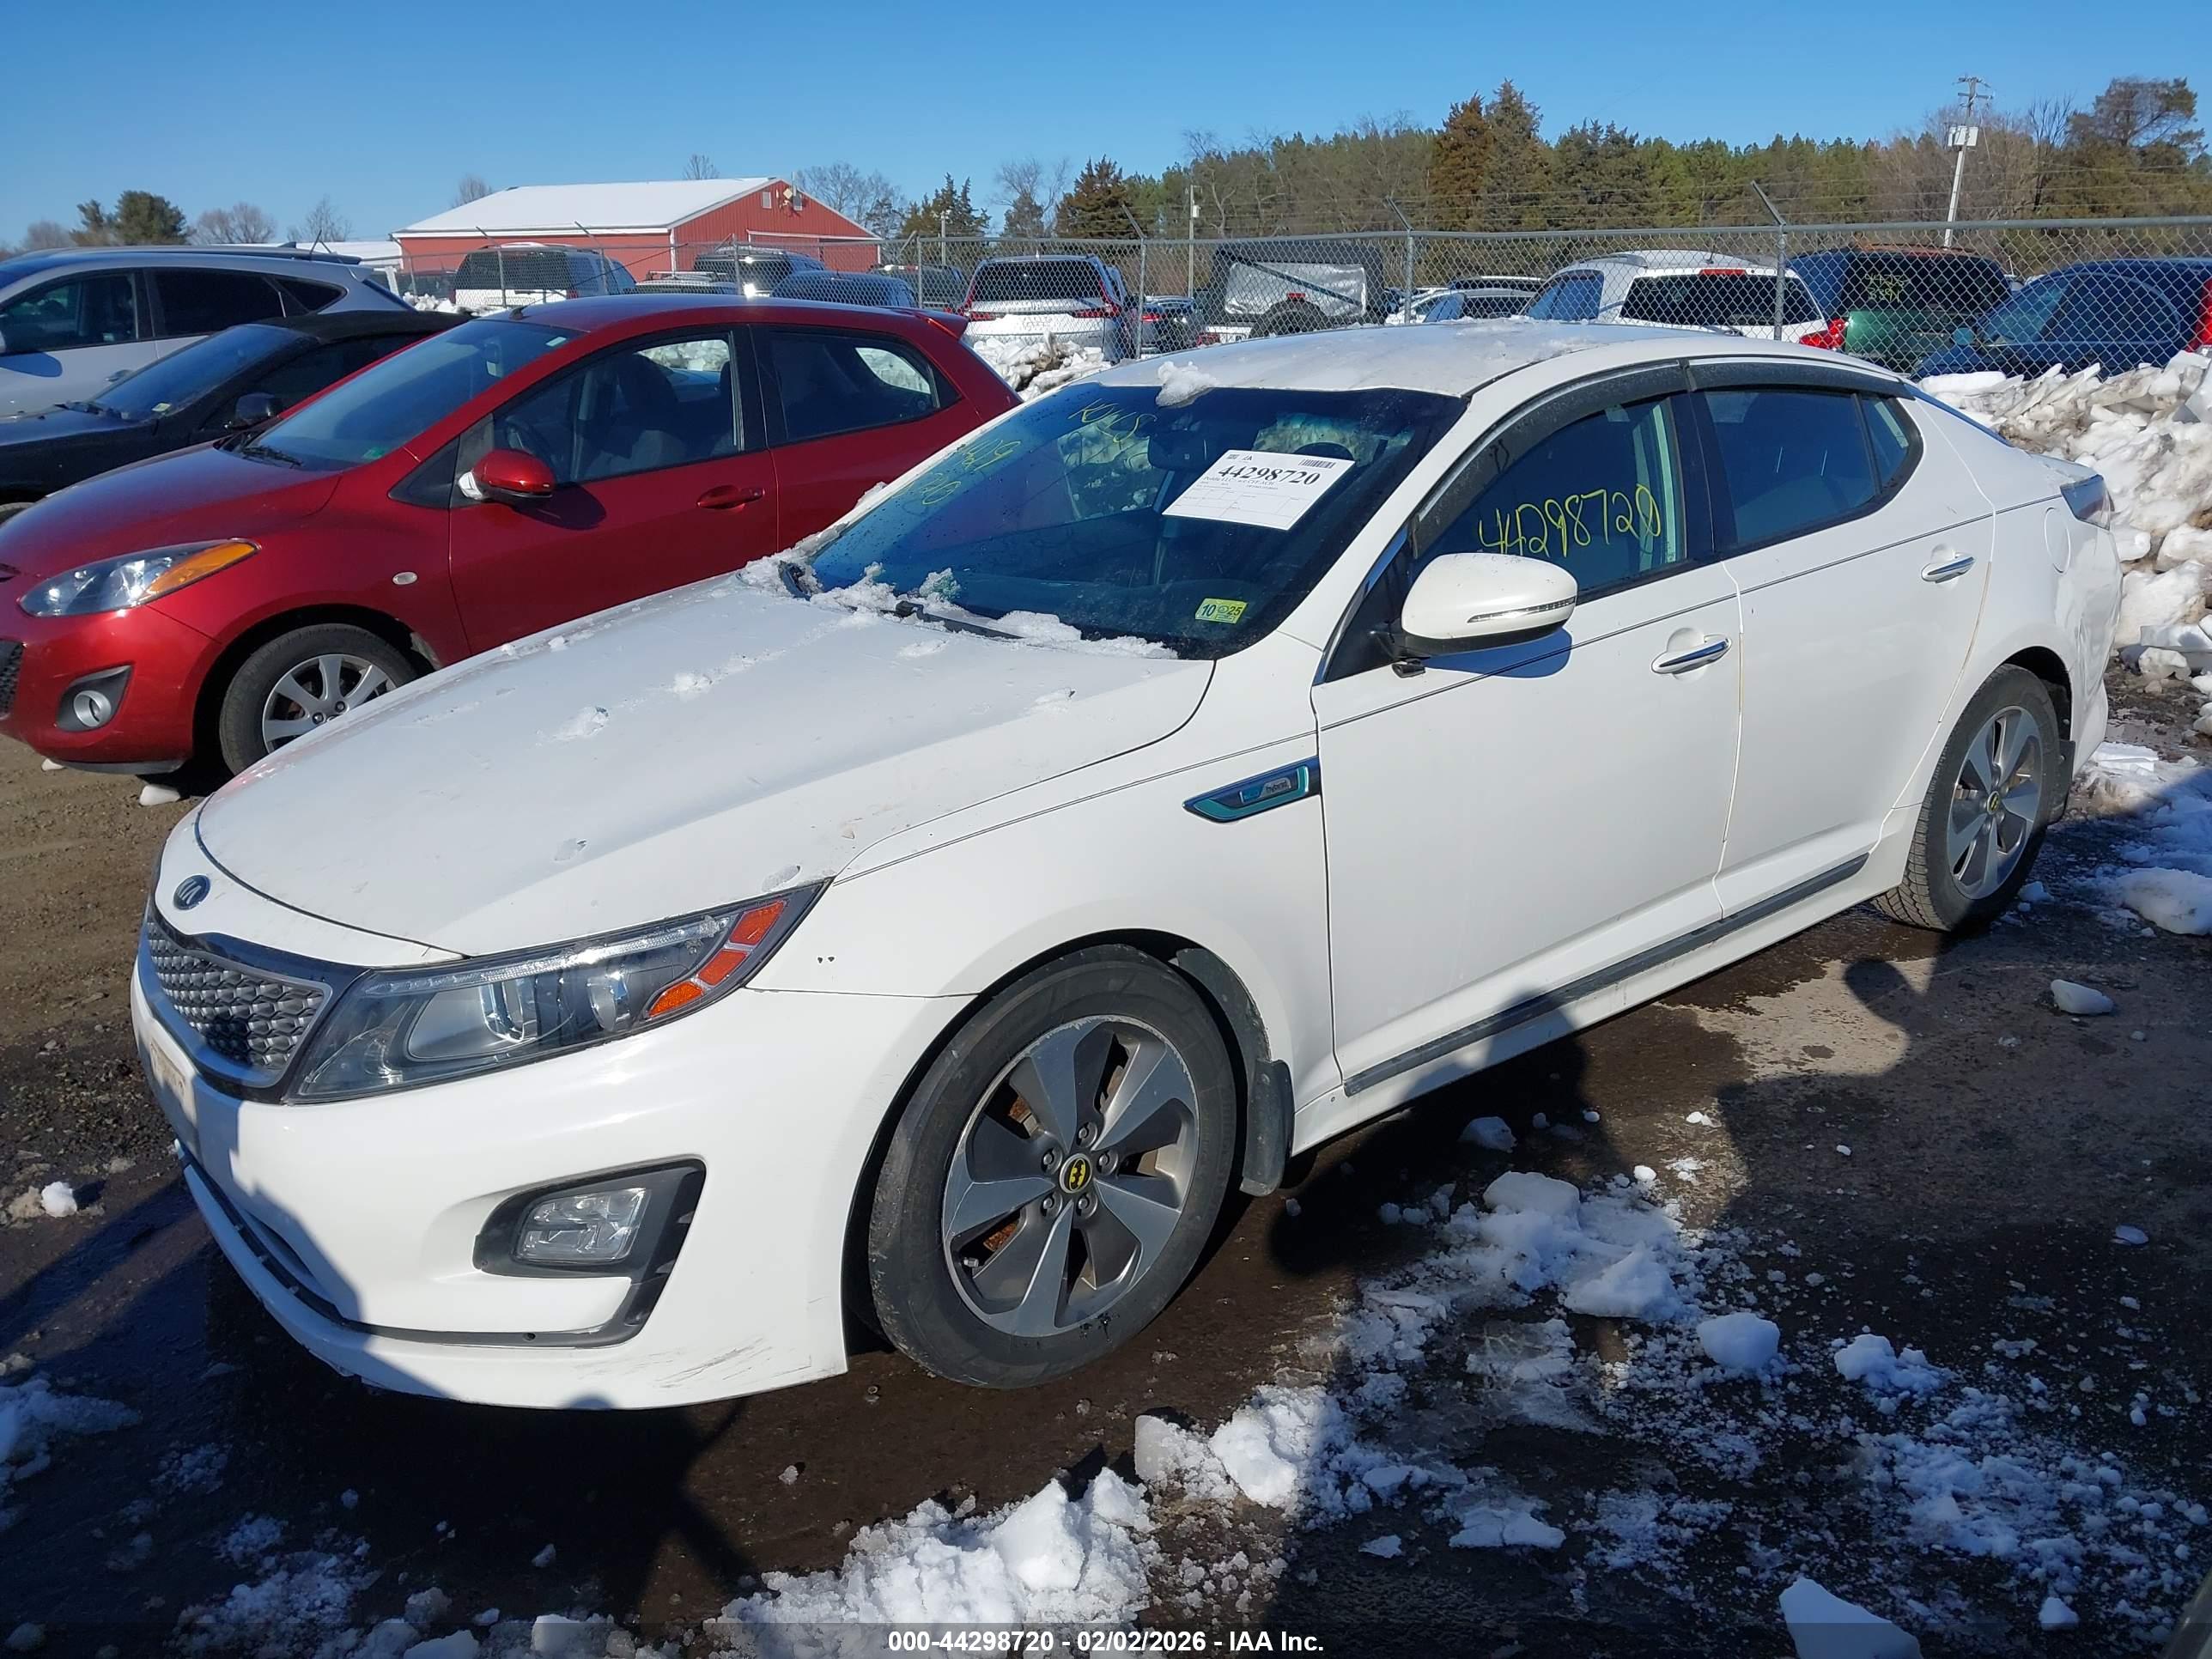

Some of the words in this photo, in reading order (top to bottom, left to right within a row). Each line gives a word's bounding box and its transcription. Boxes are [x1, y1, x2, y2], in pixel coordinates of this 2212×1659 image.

[1218, 465, 1320, 485] 44298720
[1479, 483, 1662, 558] 44298720
[1201, 604, 1217, 617] 10
[1227, 605, 1243, 617] 25
